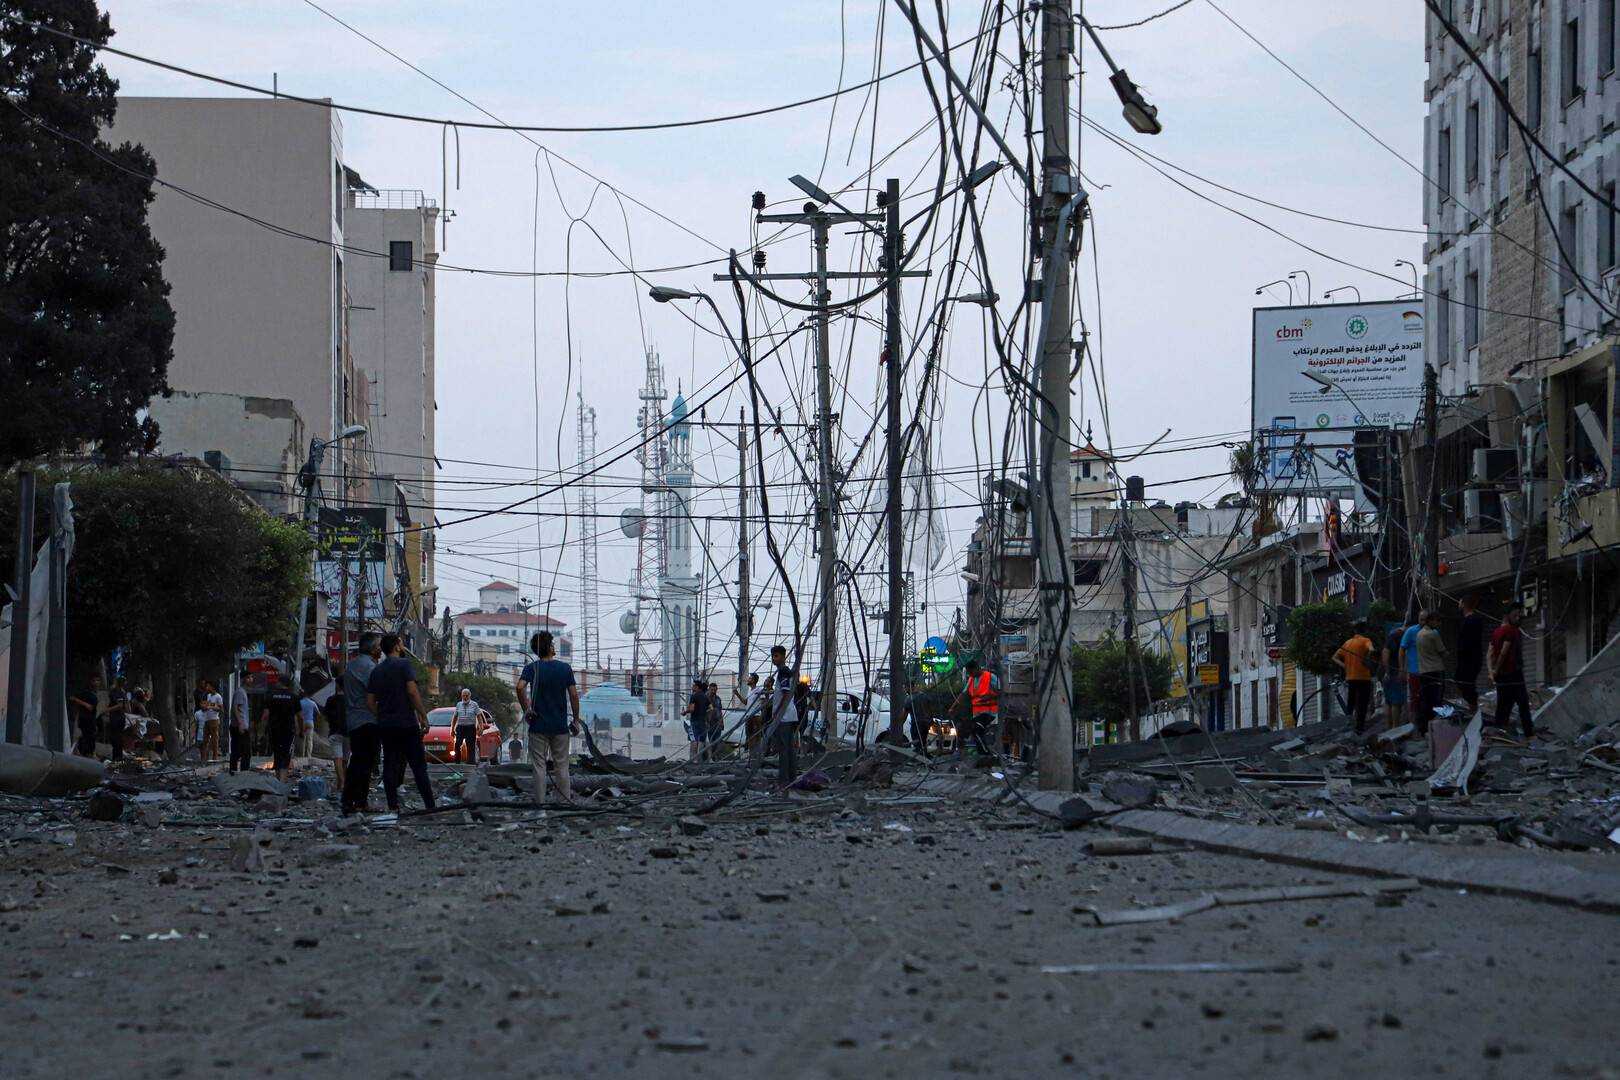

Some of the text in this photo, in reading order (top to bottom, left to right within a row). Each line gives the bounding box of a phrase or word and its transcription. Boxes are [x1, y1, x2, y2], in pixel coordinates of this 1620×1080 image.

[1276, 325, 1303, 338] cbm
[1293, 342, 1421, 357] التردد في الإبلاغ يدفع المجرم لارتكاب
[1308, 354, 1406, 368] المزيد من الجرائم الإلكترونية
